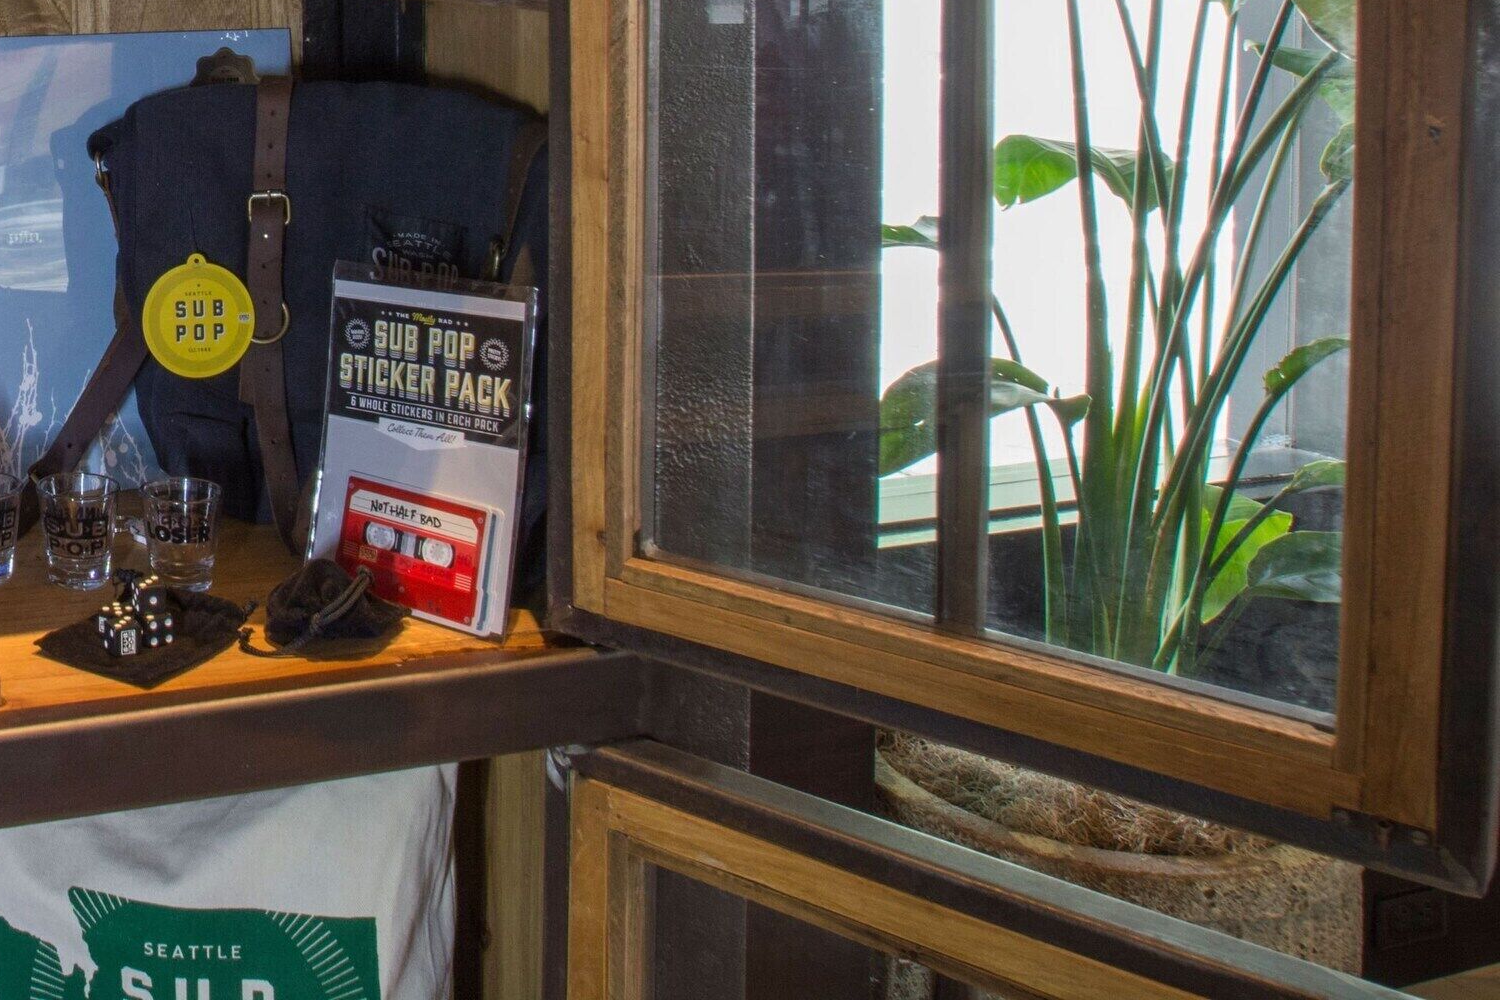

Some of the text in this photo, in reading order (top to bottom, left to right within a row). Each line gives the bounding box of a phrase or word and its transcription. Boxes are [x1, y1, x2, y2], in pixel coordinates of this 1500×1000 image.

[397, 232, 428, 240] MADE
[176, 299, 224, 318] SUB
[176, 323, 225, 342] POP
[374, 320, 476, 367] SUB POP
[339, 353, 512, 417] STICKER PACK
[350, 396, 500, 433] 6 WHOLE STICKERS IN EACH PACK
[386, 422, 414, 437] Collect
[413, 427, 435, 441] Them
[370, 499, 442, 529] NOT HALF BAD
[45, 518, 107, 537] SUB
[50, 538, 104, 556] POP
[143, 941, 242, 959] SEATTLE
